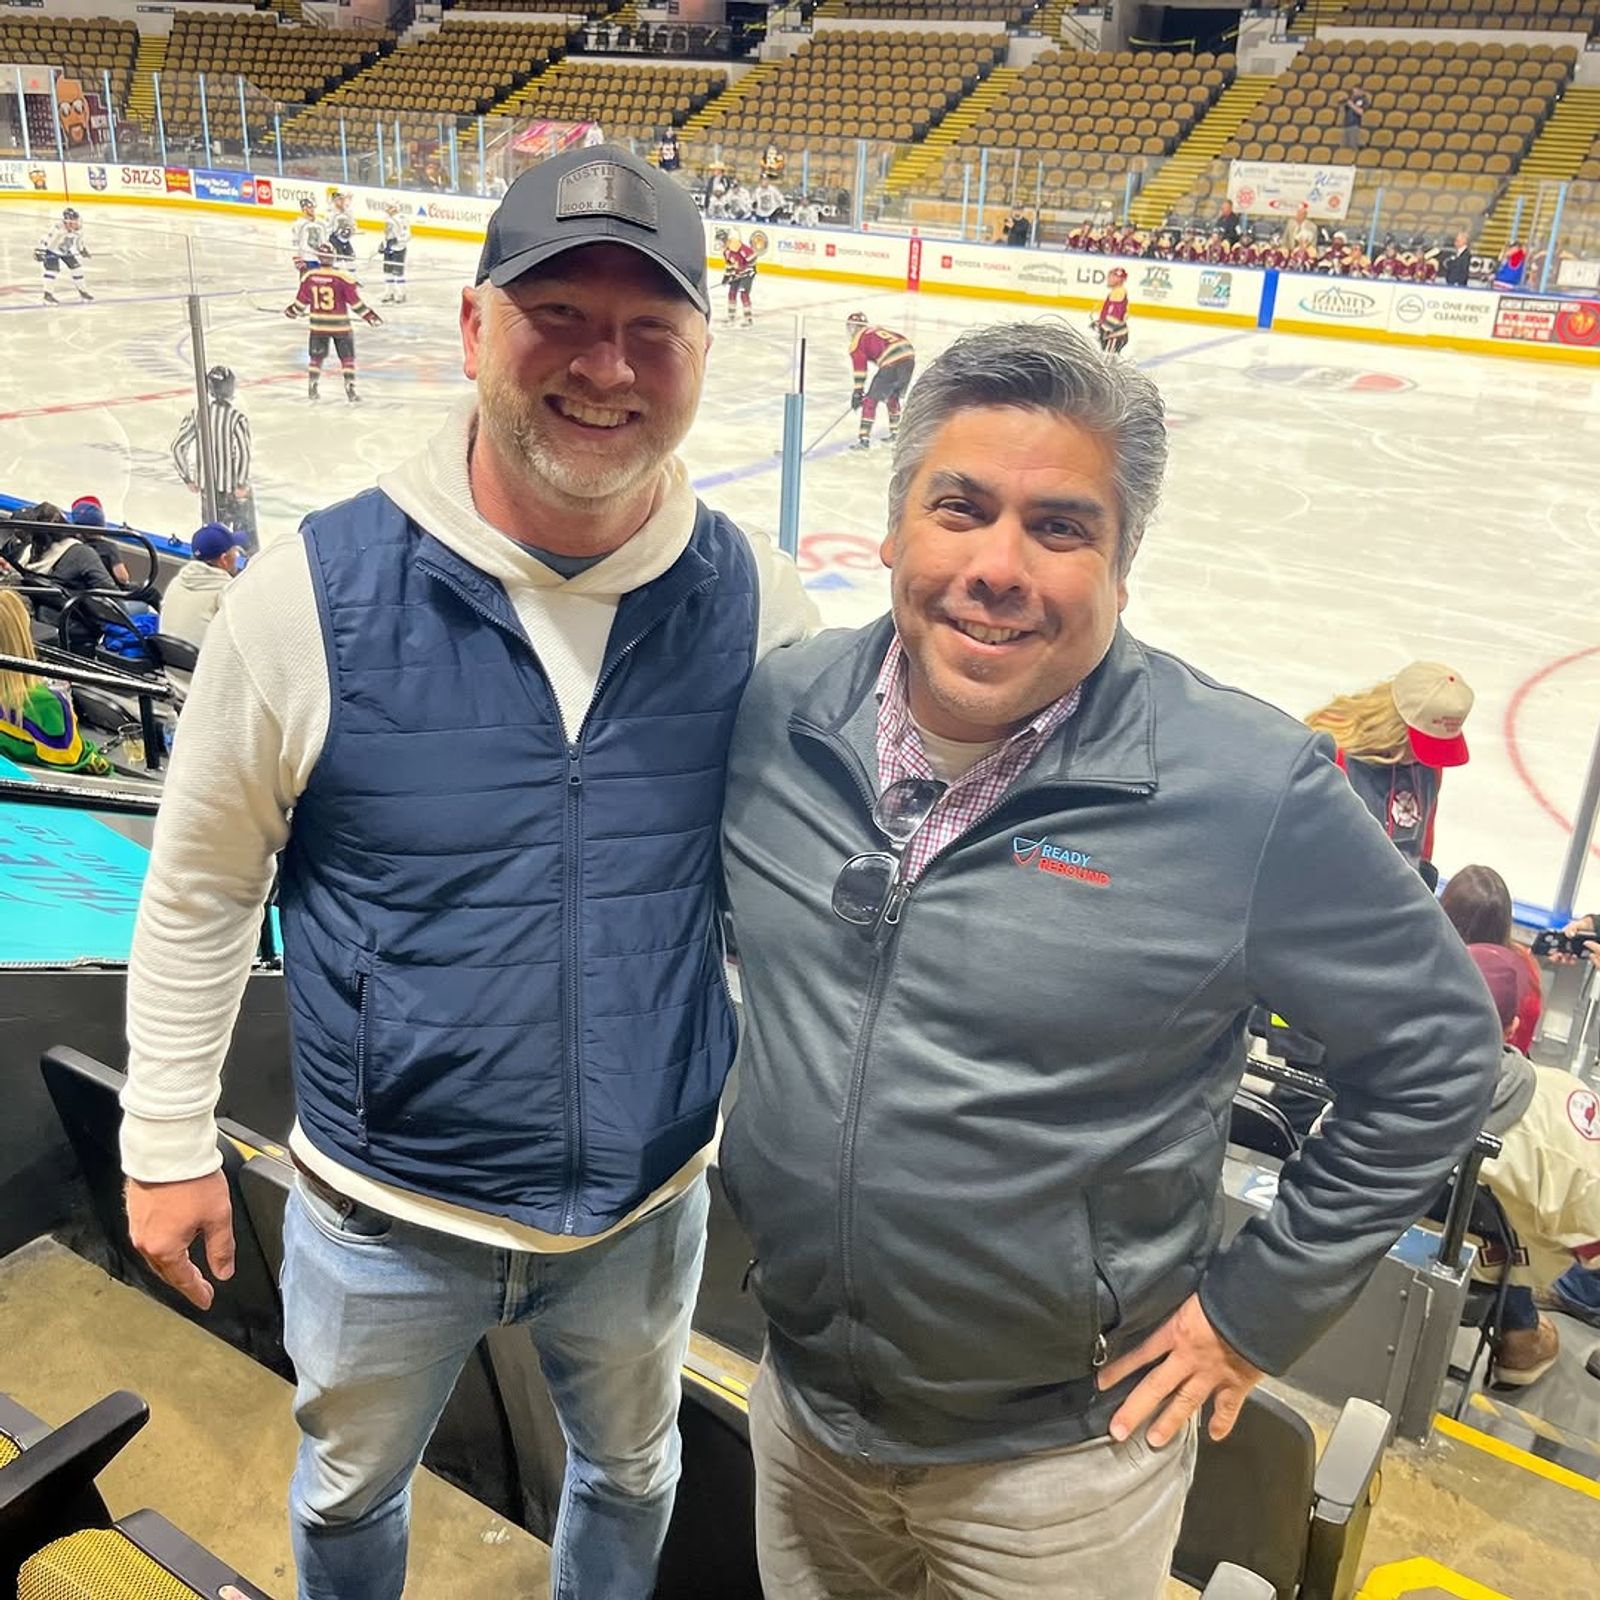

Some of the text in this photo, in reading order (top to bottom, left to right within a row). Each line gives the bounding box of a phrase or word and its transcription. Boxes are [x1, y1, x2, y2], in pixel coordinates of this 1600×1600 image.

[275, 187, 316, 202] TOYOTA
[456, 207, 482, 223] LIGHT
[311, 285, 336, 311] 13
[1442, 301, 1464, 312] ONE
[1465, 304, 1491, 314] PRICE
[1433, 312, 1479, 324] CLEANERS
[1041, 844, 1091, 867] READY
[1038, 858, 1111, 887] REBOUND
